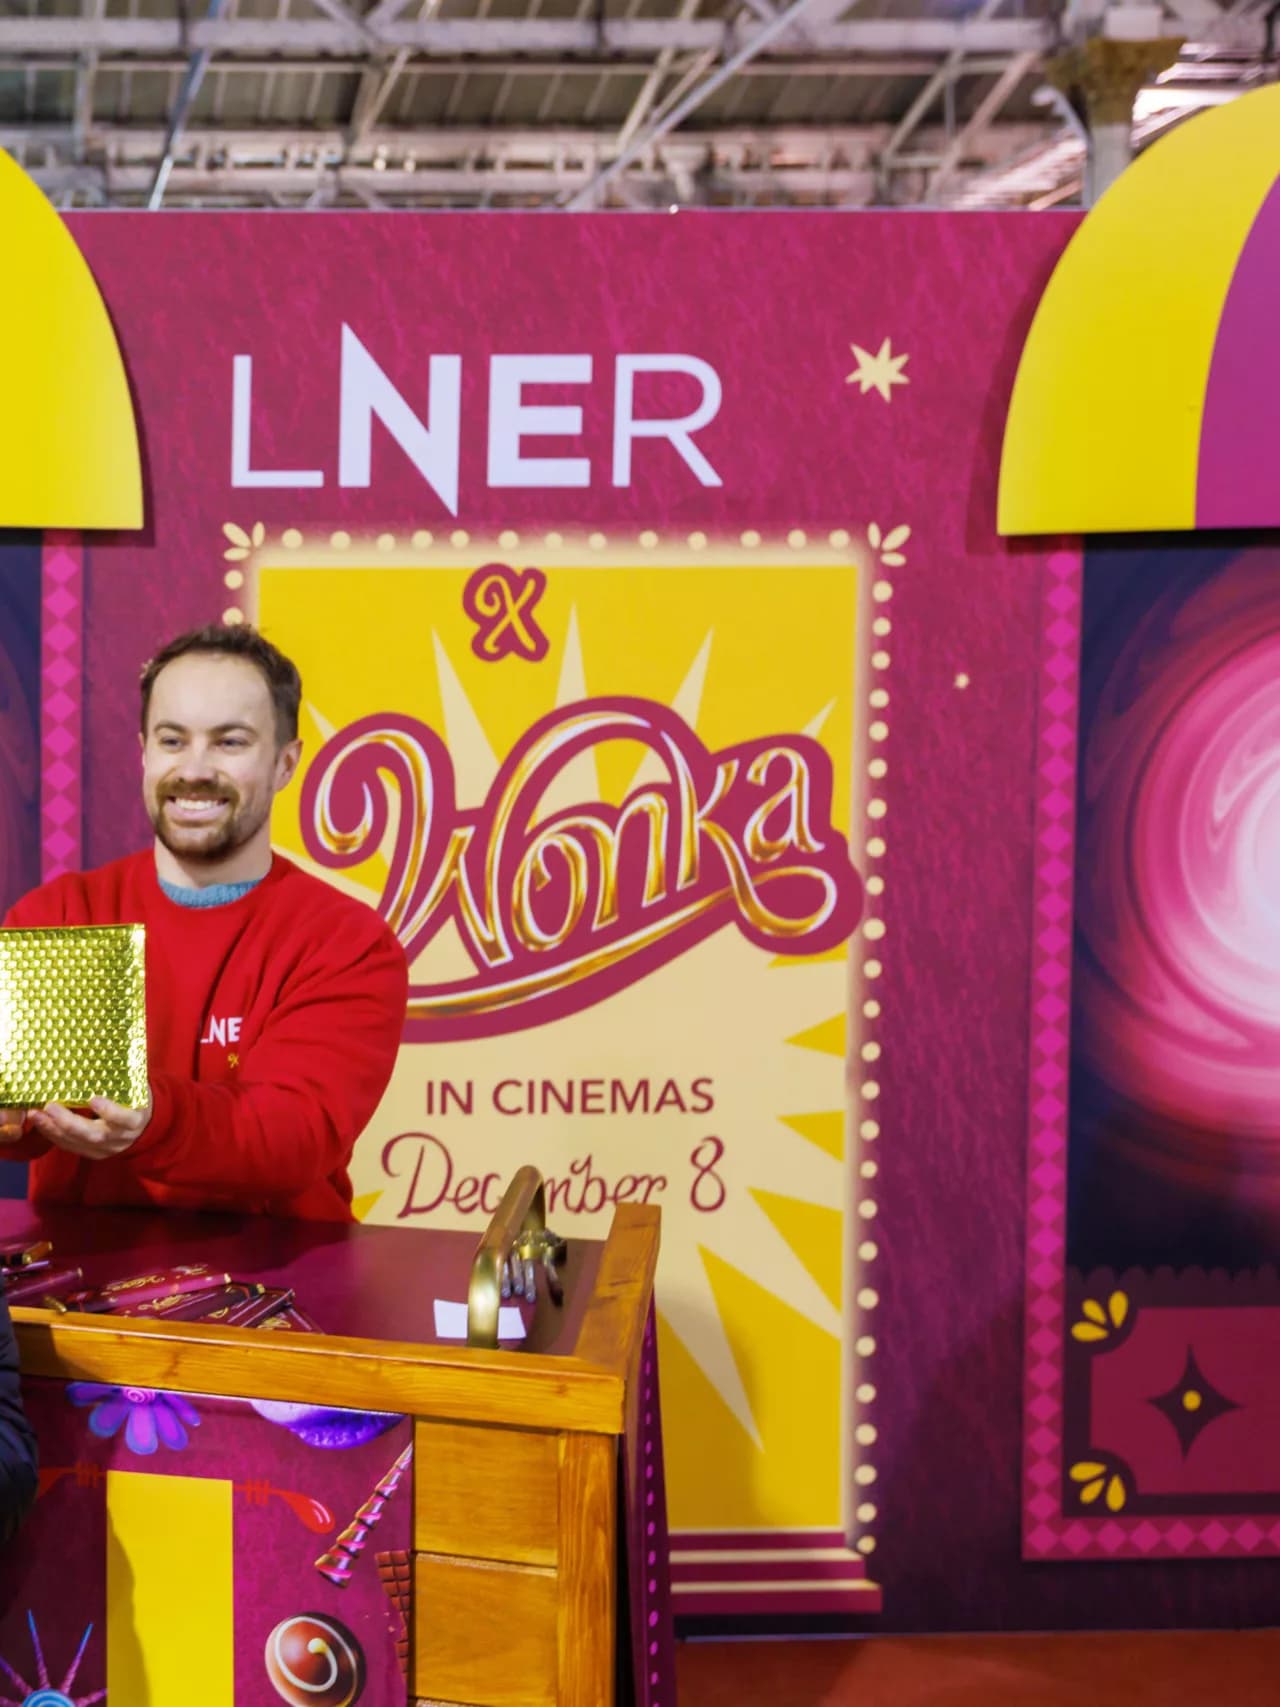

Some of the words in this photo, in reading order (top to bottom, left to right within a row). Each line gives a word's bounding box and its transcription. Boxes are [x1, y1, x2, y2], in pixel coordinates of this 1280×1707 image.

[231, 321, 722, 517] LNER
[314, 711, 837, 1019] Wonka
[426, 1080, 474, 1116] IN
[493, 1077, 715, 1116] CINEMAS
[381, 1132, 667, 1219] Decmber
[690, 1136, 726, 1212] 8
